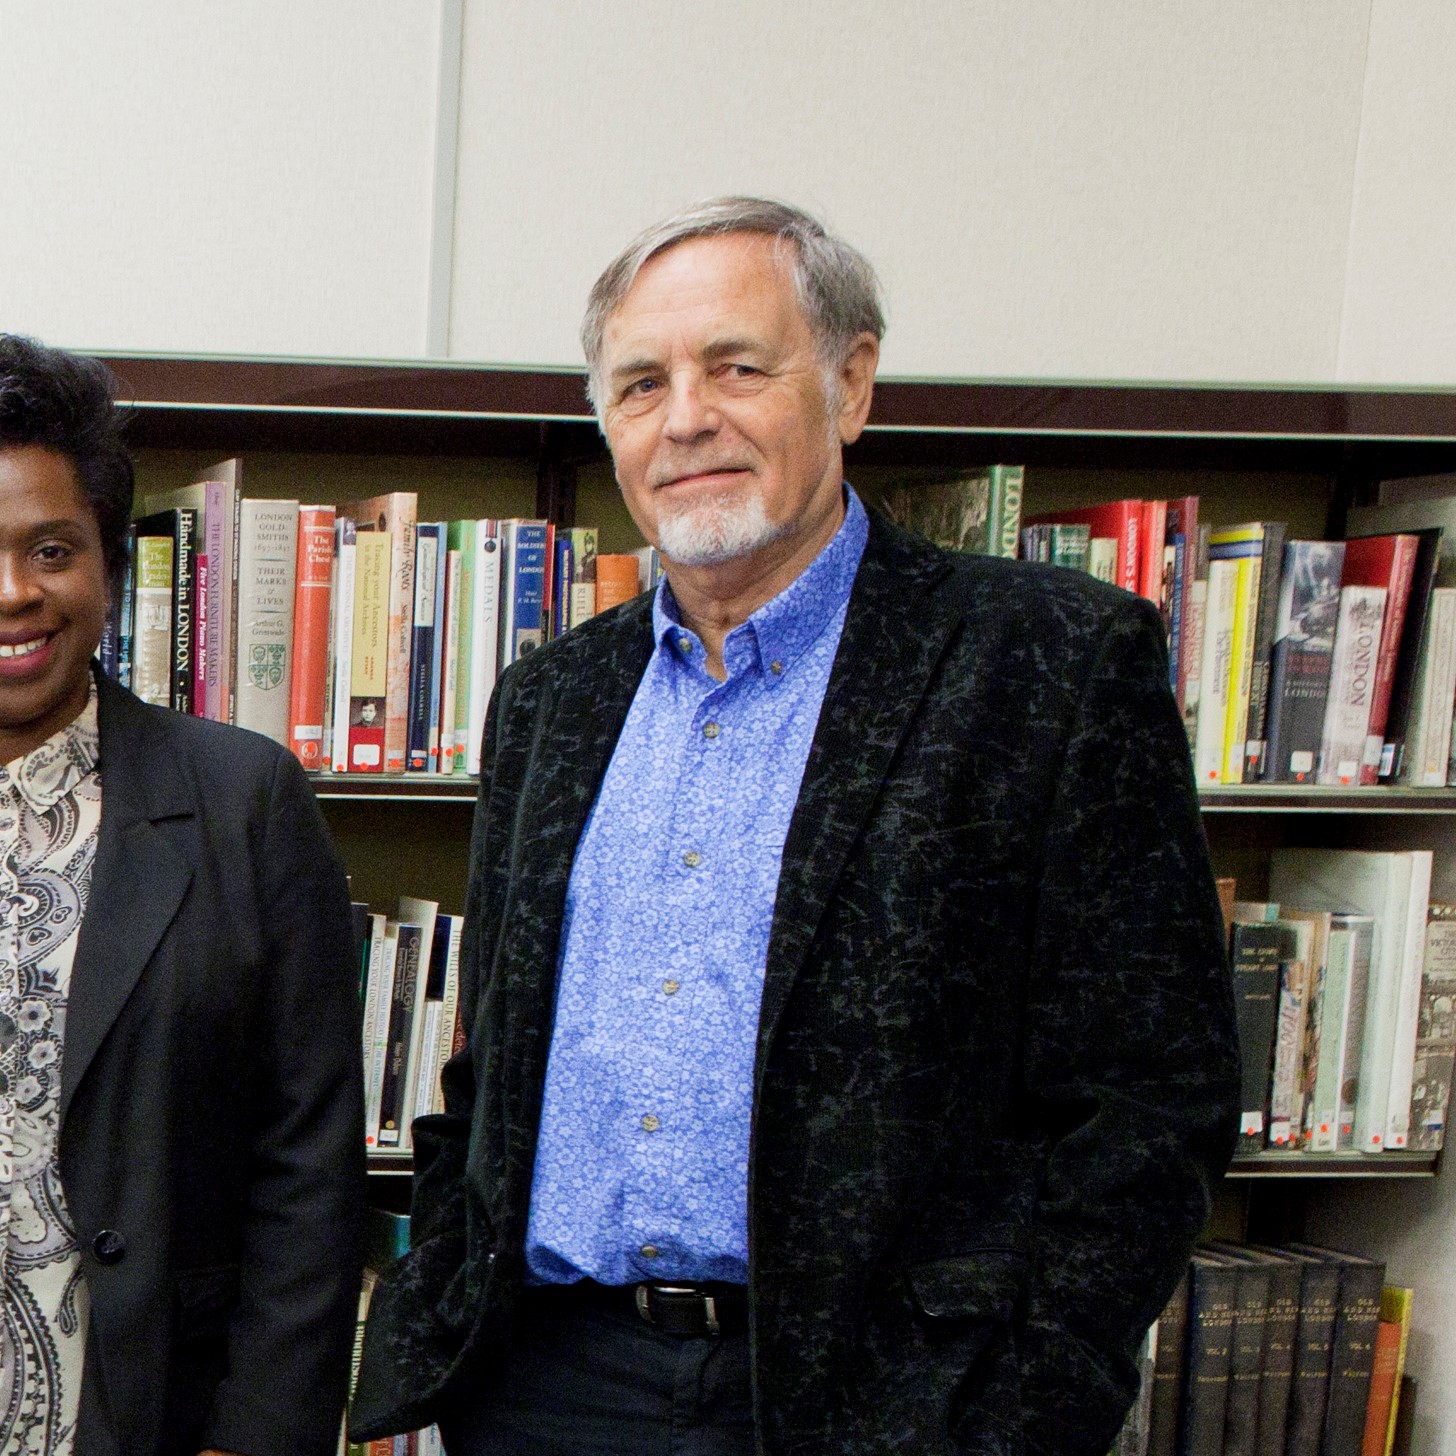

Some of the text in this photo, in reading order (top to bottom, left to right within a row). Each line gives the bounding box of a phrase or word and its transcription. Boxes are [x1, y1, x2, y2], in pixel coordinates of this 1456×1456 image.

[314, 536, 329, 544] The
[364, 553, 372, 566] the
[1126, 518, 1138, 577] LONDON'S
[176, 512, 193, 672] Handmade in LONDON
[208, 524, 221, 688] THE LONDON FURNITURE MAKERS
[363, 568, 371, 602] National
[372, 544, 384, 648] Tracing your Ancestors
[484, 562, 494, 623] MEDALS
[576, 588, 585, 618] RIFLE
[198, 566, 207, 680] Five London Piano Makers
[362, 604, 370, 635] Archives
[1350, 622, 1375, 706] LONDON
[402, 936, 420, 1013] GENEALOGY
[446, 980, 456, 993] OF
[448, 950, 460, 978] WILLS
[444, 995, 454, 1016] OUR
